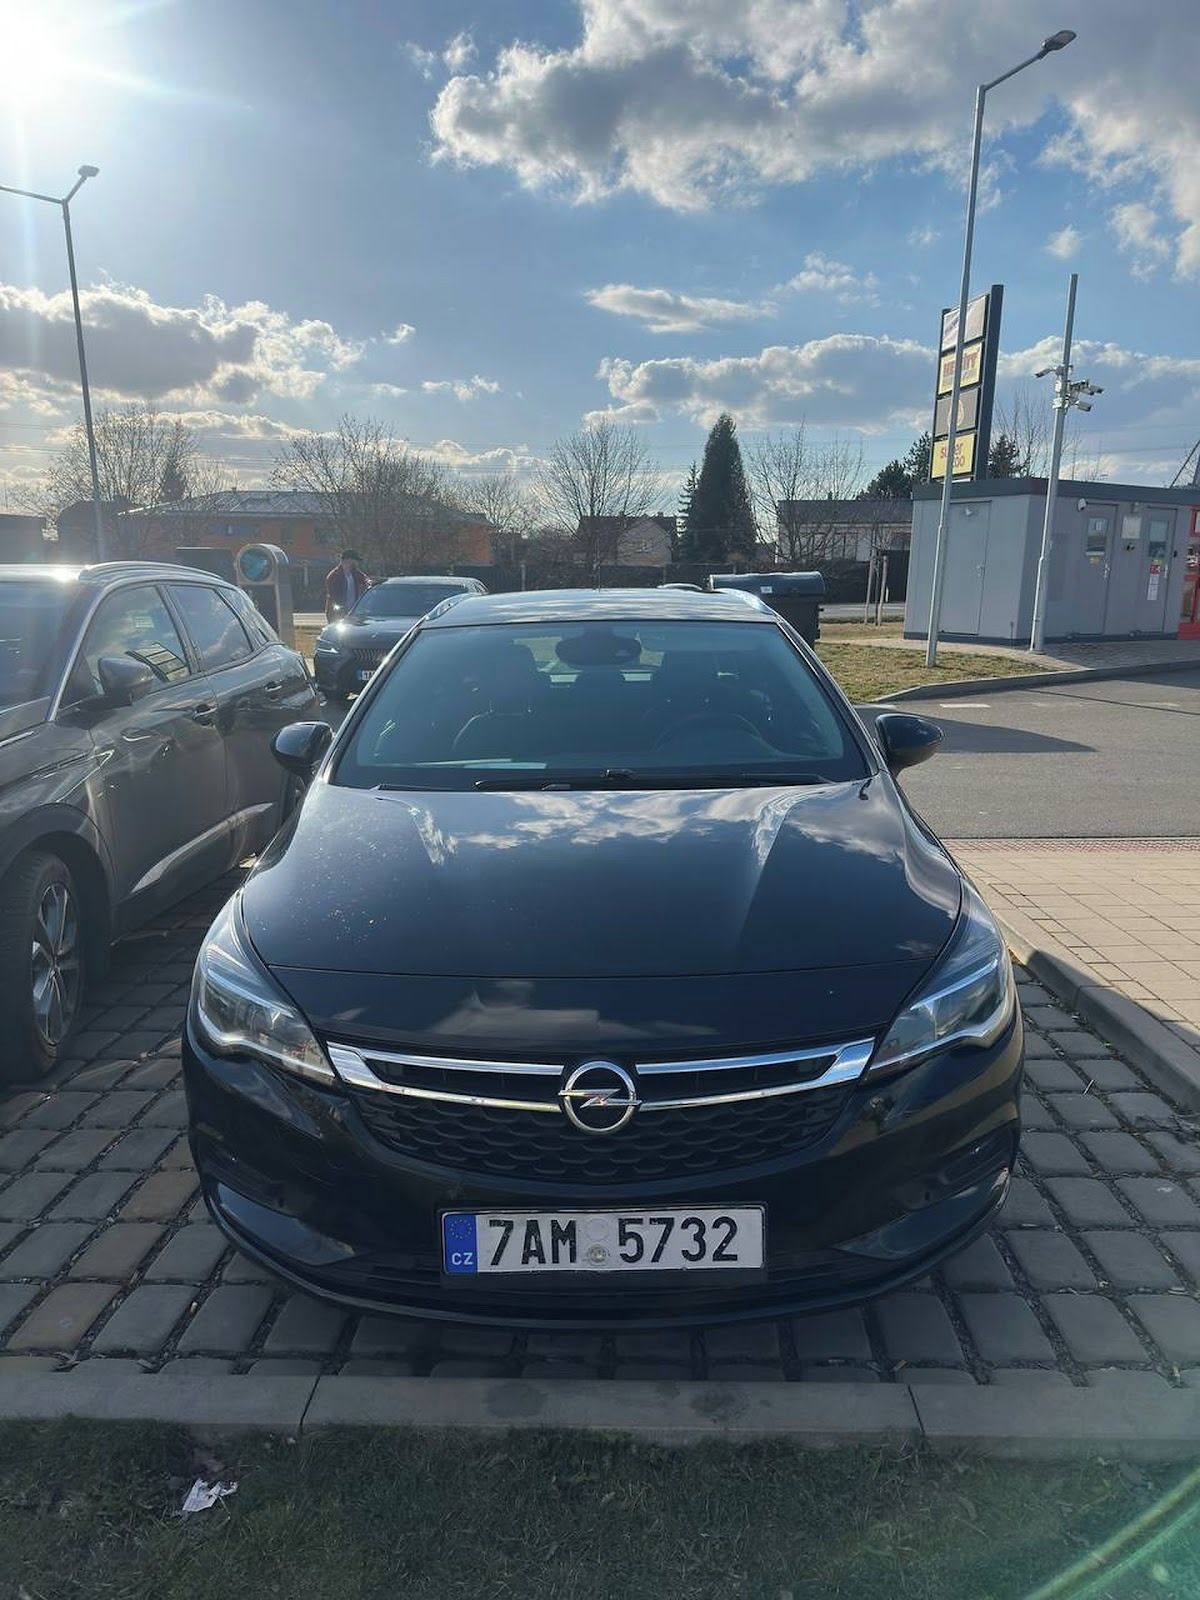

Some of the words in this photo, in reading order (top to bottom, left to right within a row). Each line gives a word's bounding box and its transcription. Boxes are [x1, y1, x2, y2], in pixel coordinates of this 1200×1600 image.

[940, 442, 964, 459] suer
[488, 1219, 577, 1266] 7AM
[617, 1216, 739, 1264] 5732
[451, 1252, 474, 1266] CZ
